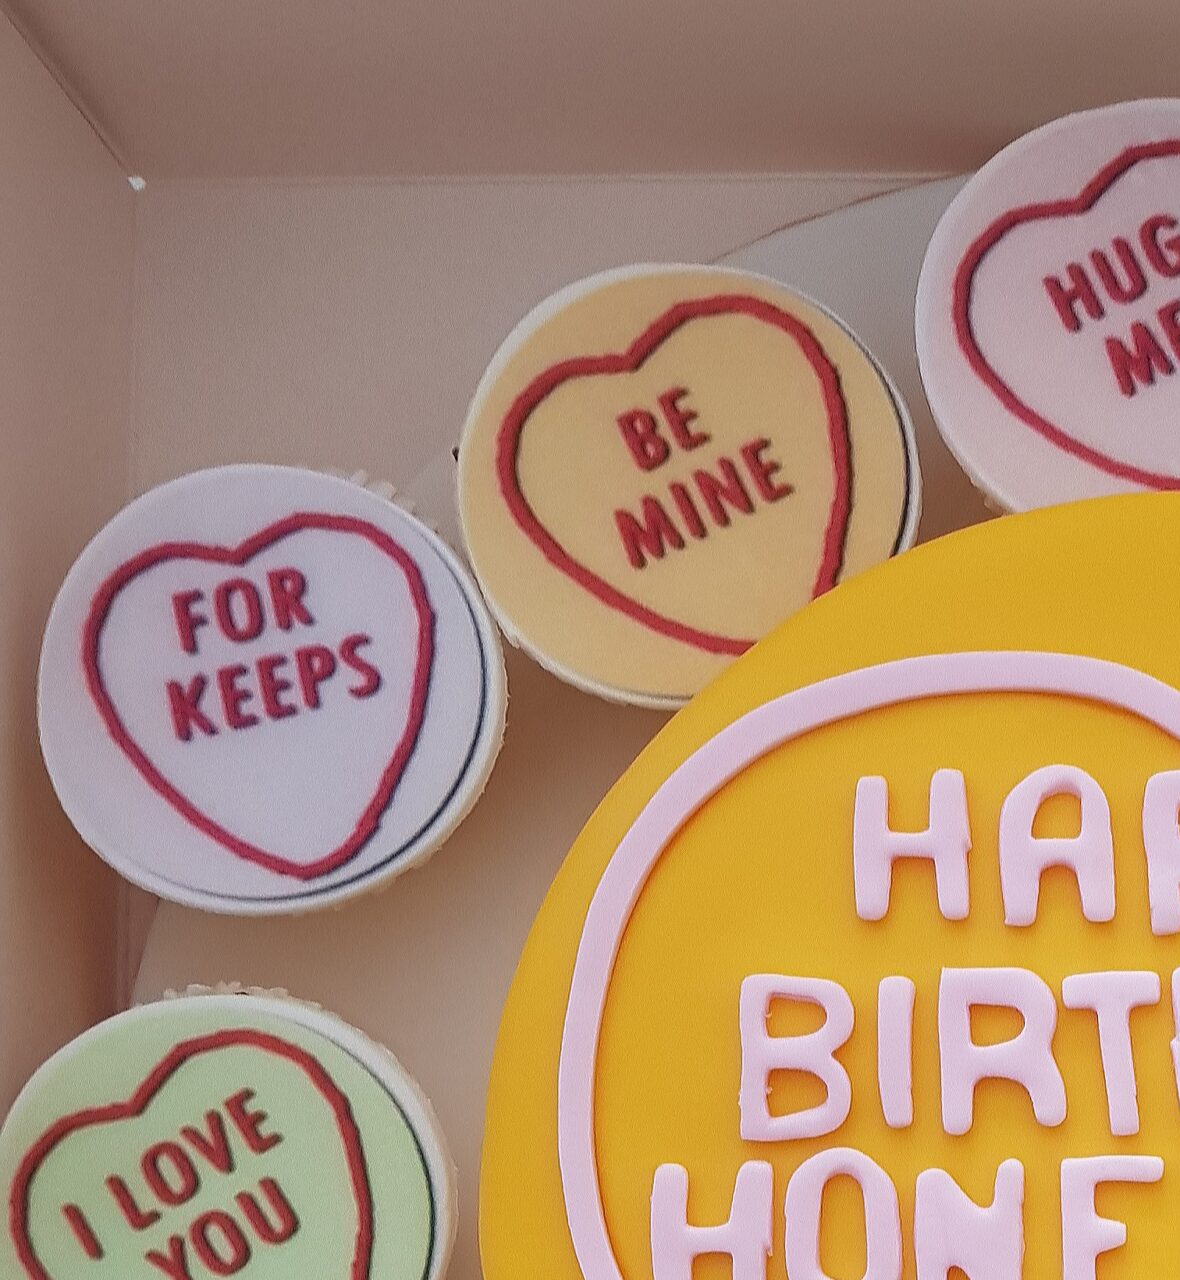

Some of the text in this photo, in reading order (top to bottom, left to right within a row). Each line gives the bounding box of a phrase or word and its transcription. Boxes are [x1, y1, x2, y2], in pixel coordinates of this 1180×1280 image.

[617, 387, 711, 470] BE
[615, 438, 794, 569] MINE
[172, 568, 315, 655] FOR
[166, 634, 383, 742] KEEPS
[62, 1089, 283, 1261] I LOVE
